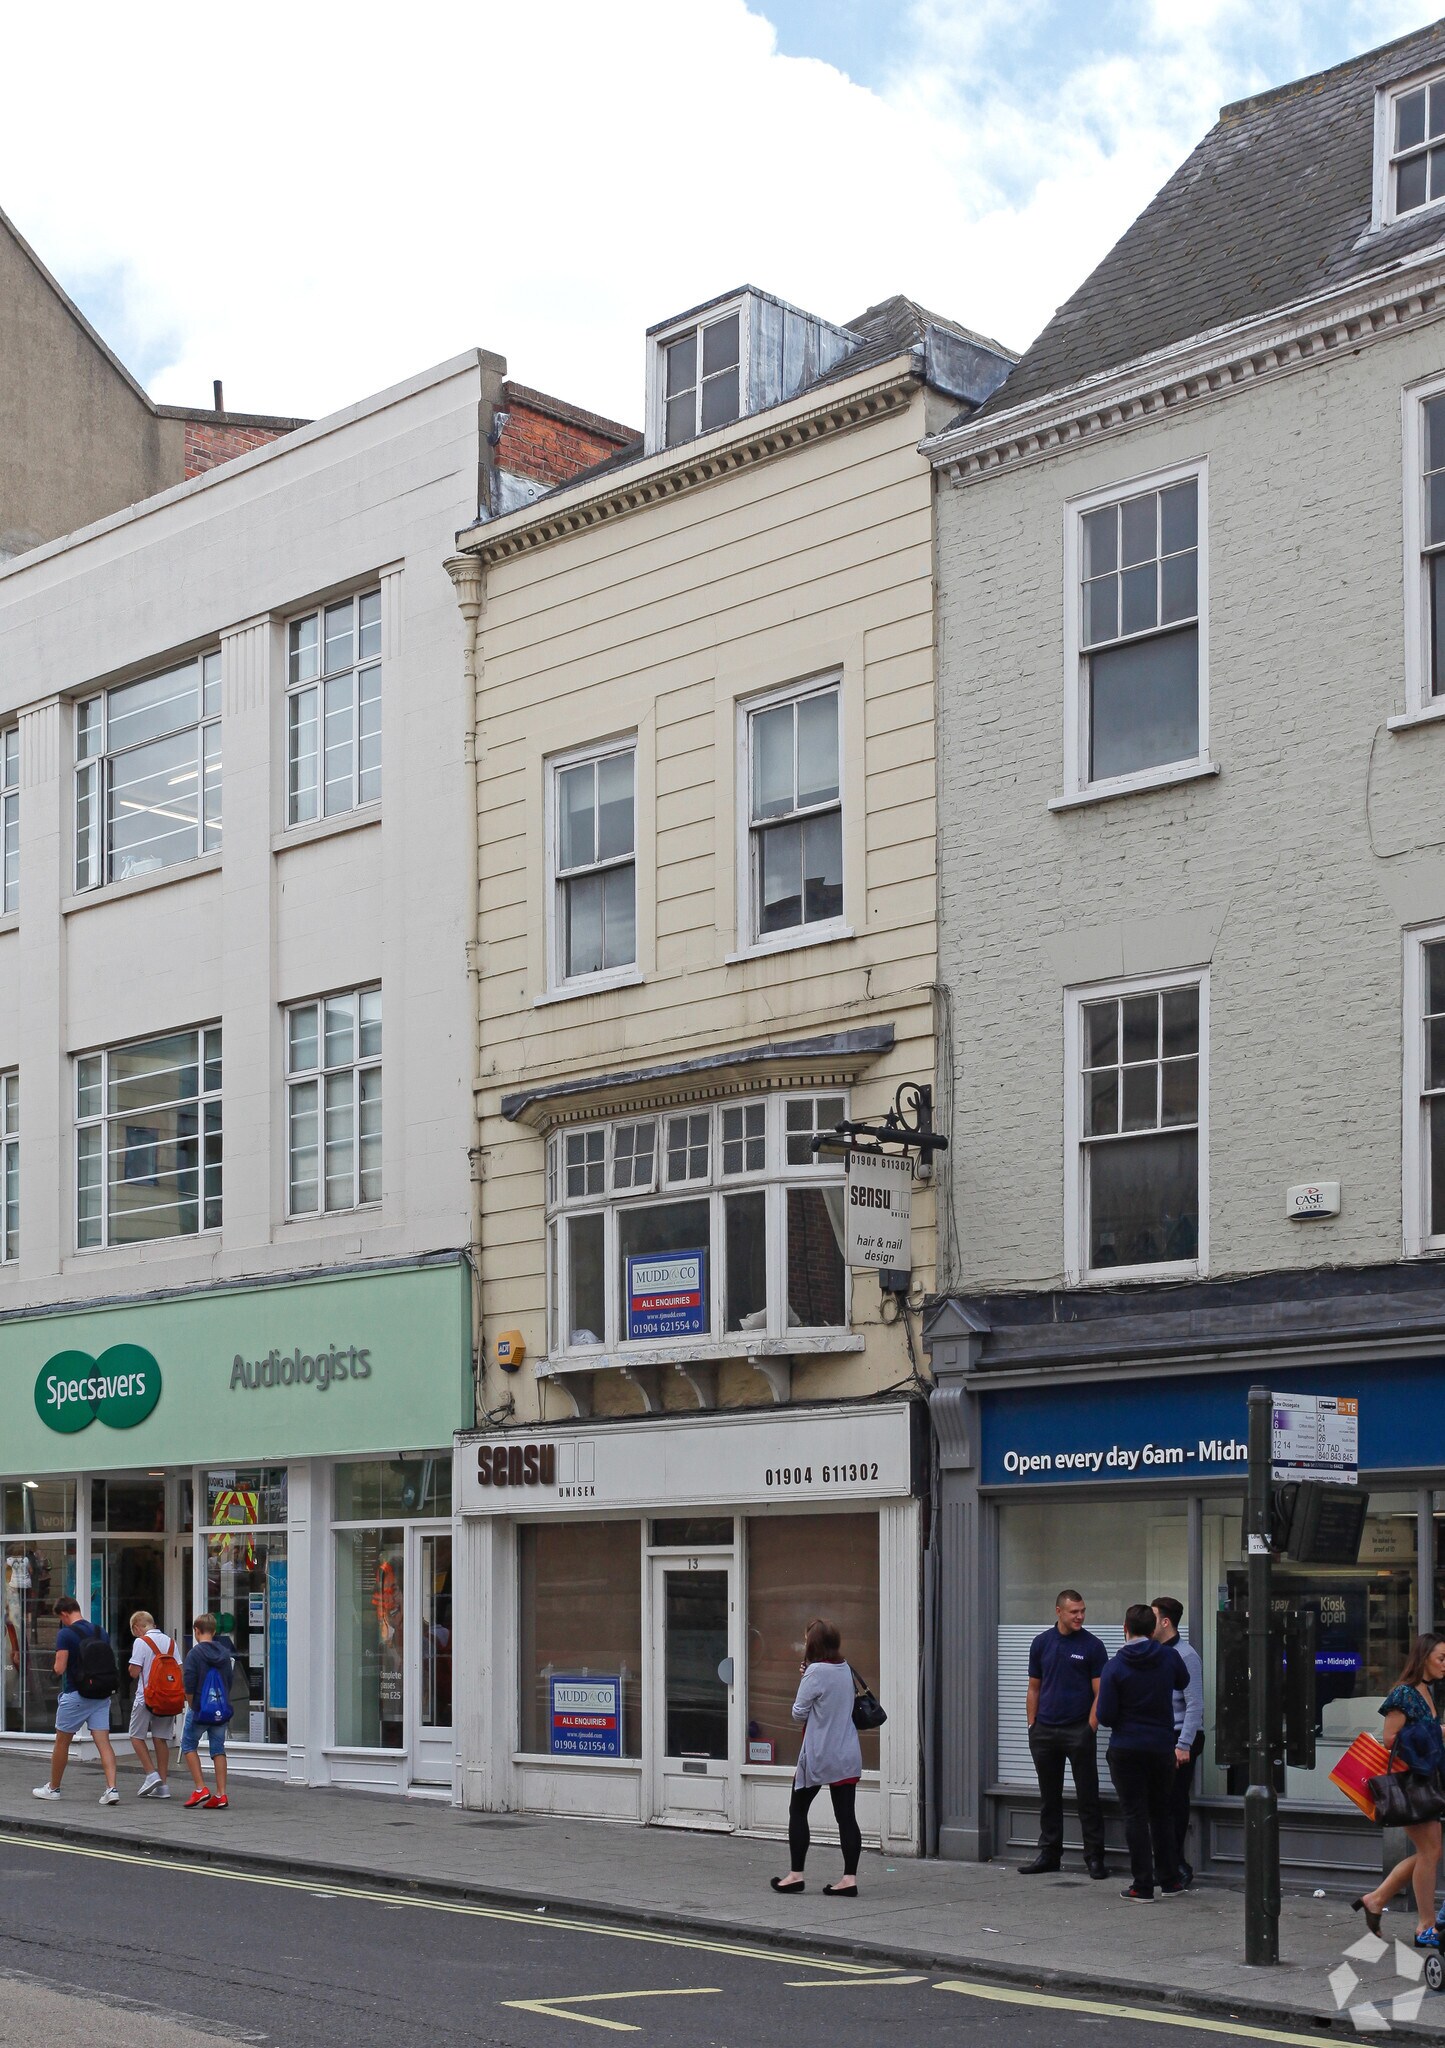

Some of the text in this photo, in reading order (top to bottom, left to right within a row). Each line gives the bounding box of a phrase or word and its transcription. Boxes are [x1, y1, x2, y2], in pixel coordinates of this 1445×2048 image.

[851, 1154, 911, 1172] 01904 611302
[850, 1185, 891, 1210] sensu
[1295, 1193, 1324, 1206] CASE
[857, 1234, 903, 1250] hair & nail
[864, 1250, 895, 1265] design
[636, 1269, 669, 1284] MUDD
[680, 1266, 696, 1279] CO
[642, 1296, 691, 1308] ALL ENQUIRIES
[633, 1321, 690, 1334] 01904 621554
[498, 1343, 510, 1355] ADT
[229, 1343, 372, 1391] Audiologists
[46, 1371, 146, 1410] Specsavers
[1346, 1402, 1356, 1413] TE
[1274, 1411, 1279, 1419] 4
[1317, 1413, 1325, 1422] 24
[1274, 1420, 1279, 1429] 6
[1318, 1424, 1326, 1432] 21
[1274, 1430, 1281, 1438] 11
[1318, 1433, 1326, 1443] 26
[1273, 1440, 1281, 1449] 12
[1283, 1441, 1291, 1449] 14
[1317, 1443, 1325, 1452] 37
[1327, 1443, 1340, 1453] TAD
[1003, 1451, 1051, 1475] Open
[1055, 1452, 1103, 1471] every
[1106, 1446, 1140, 1470] day
[1142, 1443, 1184, 1465] 6am
[1273, 1450, 1281, 1459] 13
[1318, 1451, 1330, 1461] 840
[1331, 1452, 1341, 1461] 843
[1342, 1453, 1354, 1462] 845
[477, 1443, 555, 1487] sensu
[765, 1462, 879, 1486] 01904 611302
[558, 1486, 596, 1498] UNISEX
[687, 1558, 699, 1570] 13
[1274, 1600, 1290, 1612] pay
[1320, 1596, 1346, 1611] Kiosk
[1320, 1611, 1346, 1627] open
[1327, 1657, 1356, 1667] Midnight
[557, 1690, 588, 1703] MUDD
[597, 1691, 612, 1703] CO
[562, 1717, 607, 1726] ALL ENQUIRIES
[554, 1740, 606, 1751] 01904 621554
